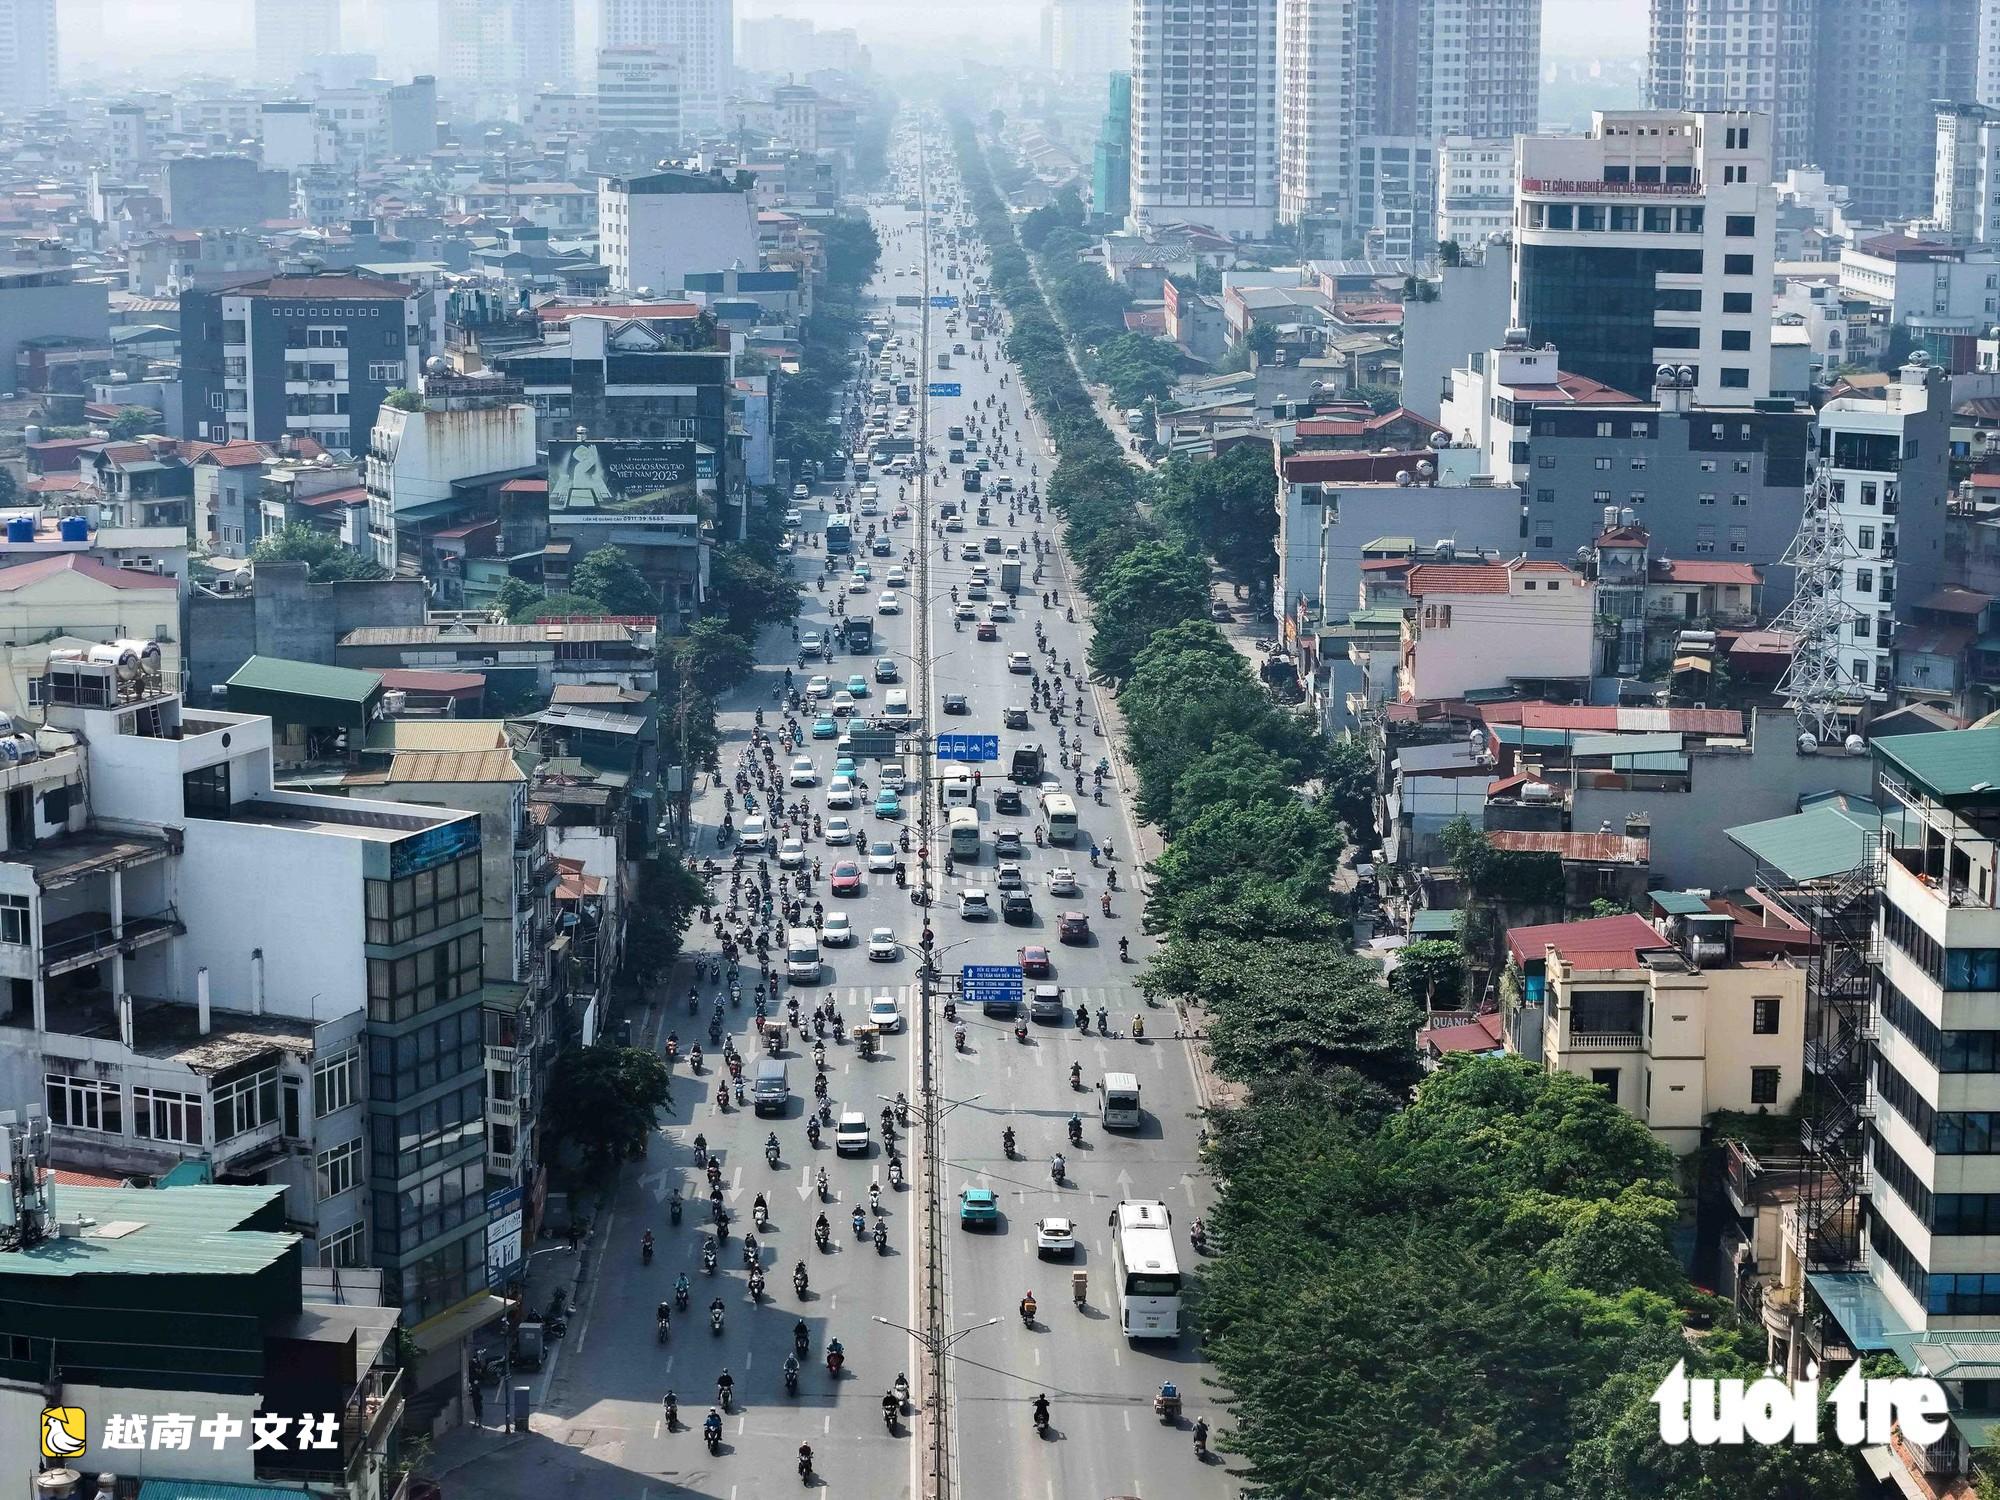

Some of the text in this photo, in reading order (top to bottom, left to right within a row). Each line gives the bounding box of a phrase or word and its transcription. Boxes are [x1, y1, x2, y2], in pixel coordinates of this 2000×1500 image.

[1552, 178, 1575, 192] CÔNG
[1576, 179, 1605, 194] NGHIỆP
[609, 463, 634, 472] QUẢNG
[652, 471, 678, 481] 2025
